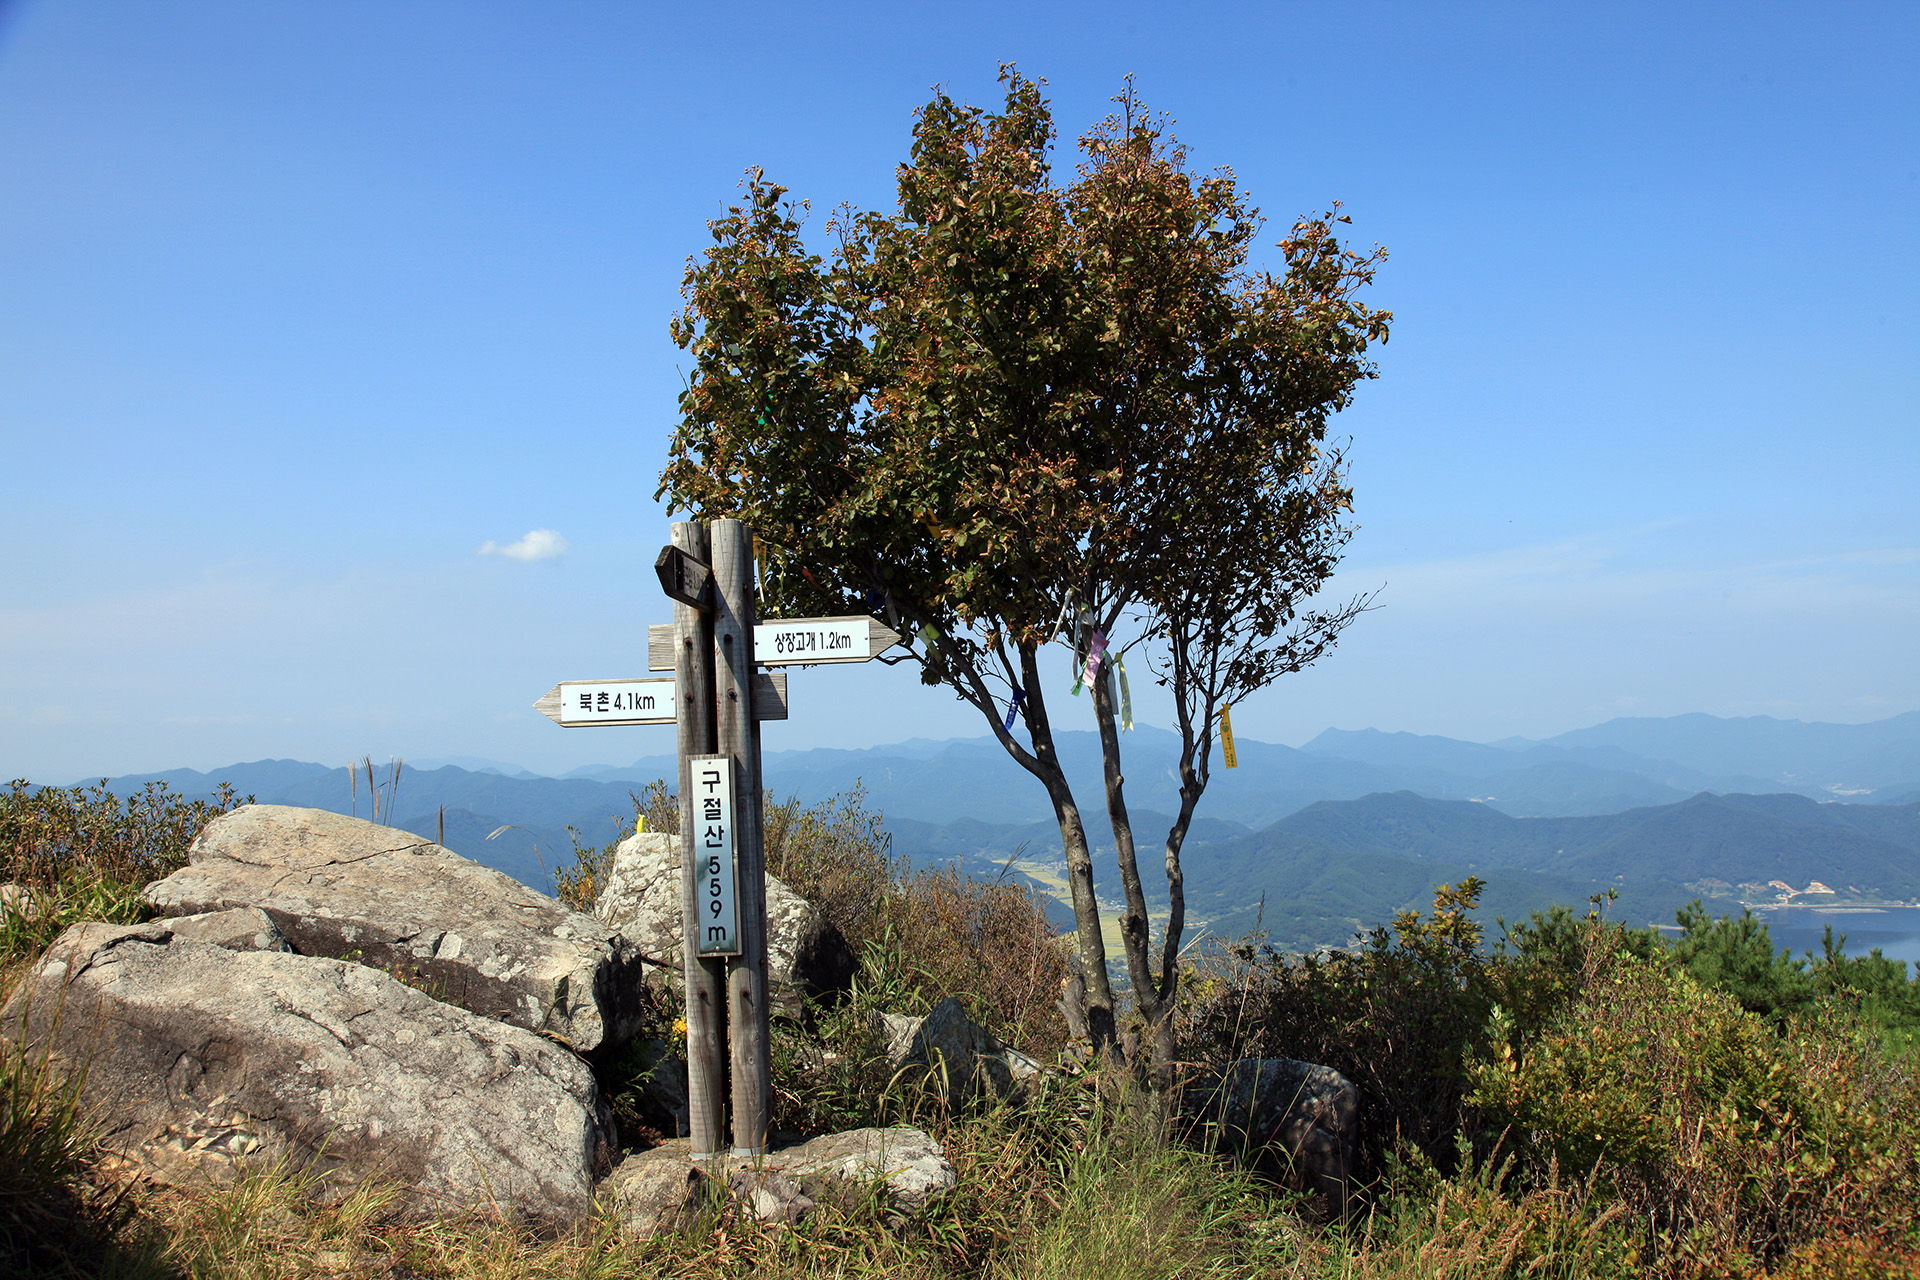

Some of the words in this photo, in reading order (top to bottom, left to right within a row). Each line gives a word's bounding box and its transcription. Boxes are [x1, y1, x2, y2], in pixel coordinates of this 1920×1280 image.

[774, 631, 816, 654] 상장고개
[819, 631, 852, 650] 1.2km
[613, 692, 655, 711] 4.1km
[702, 770, 724, 849] 구절산
[708, 855, 727, 942] 559m
